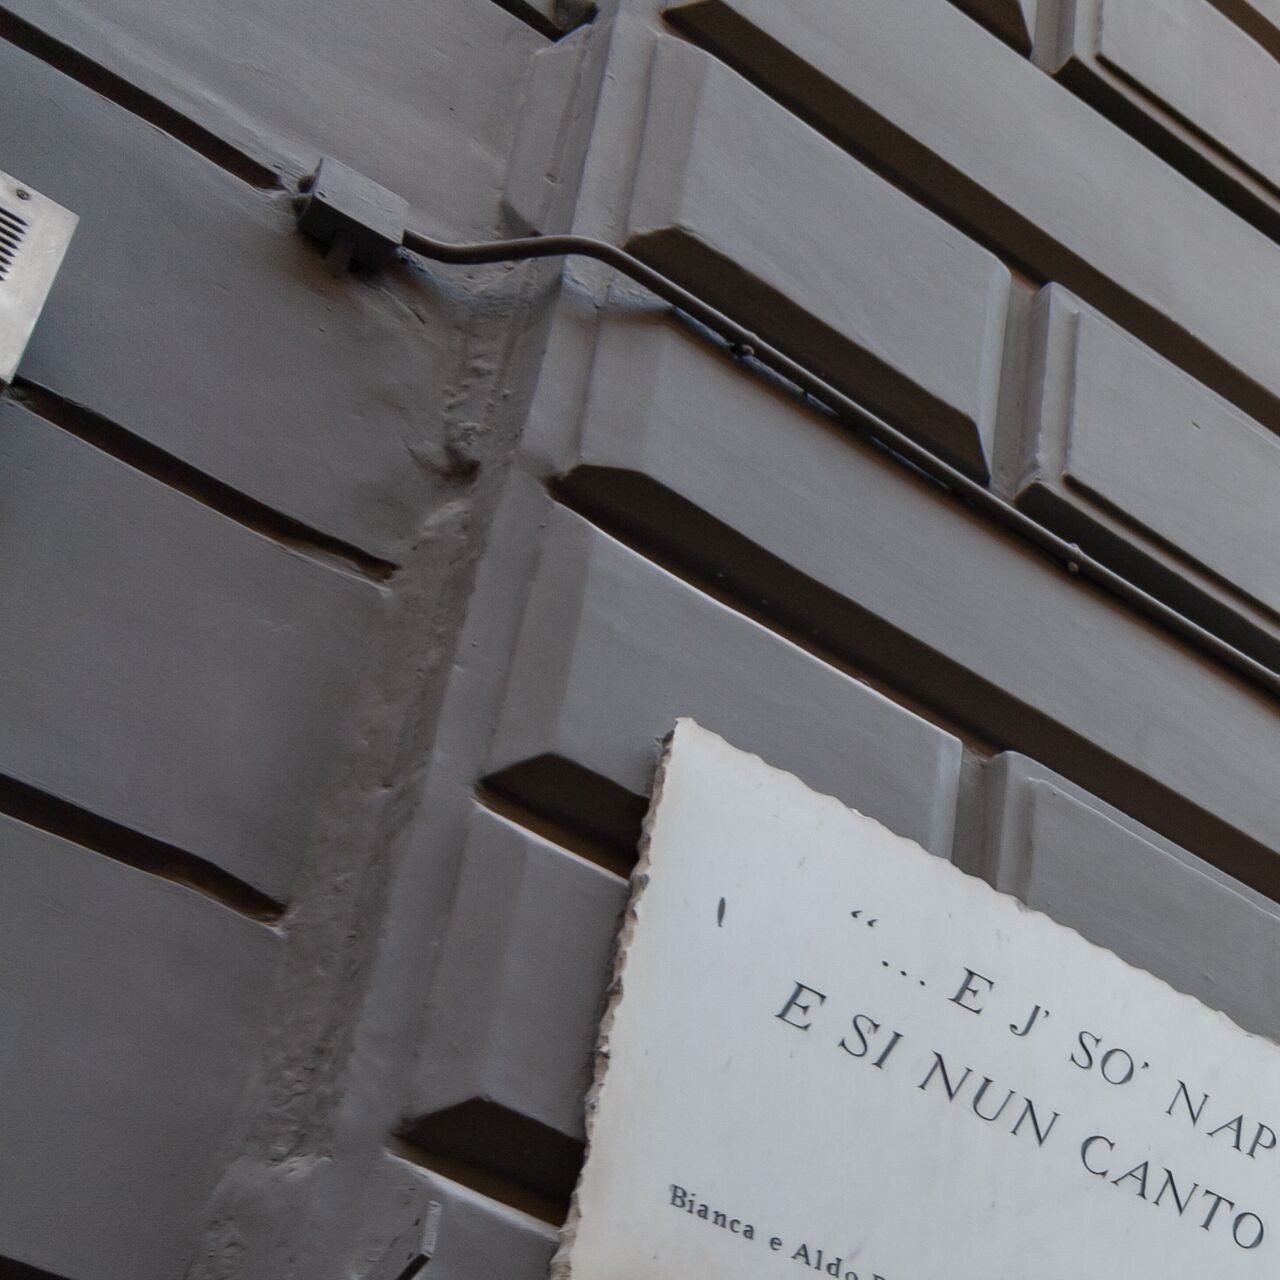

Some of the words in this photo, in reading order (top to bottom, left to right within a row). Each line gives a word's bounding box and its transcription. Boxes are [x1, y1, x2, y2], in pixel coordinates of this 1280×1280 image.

[947, 966, 996, 1016] E
[773, 980, 828, 1033] E
[837, 1013, 905, 1070] SI
[917, 1050, 1061, 1148] NUN
[1079, 1134, 1265, 1250] CANTO
[669, 1183, 755, 1241] Bianca
[768, 1236, 783, 1252] e
